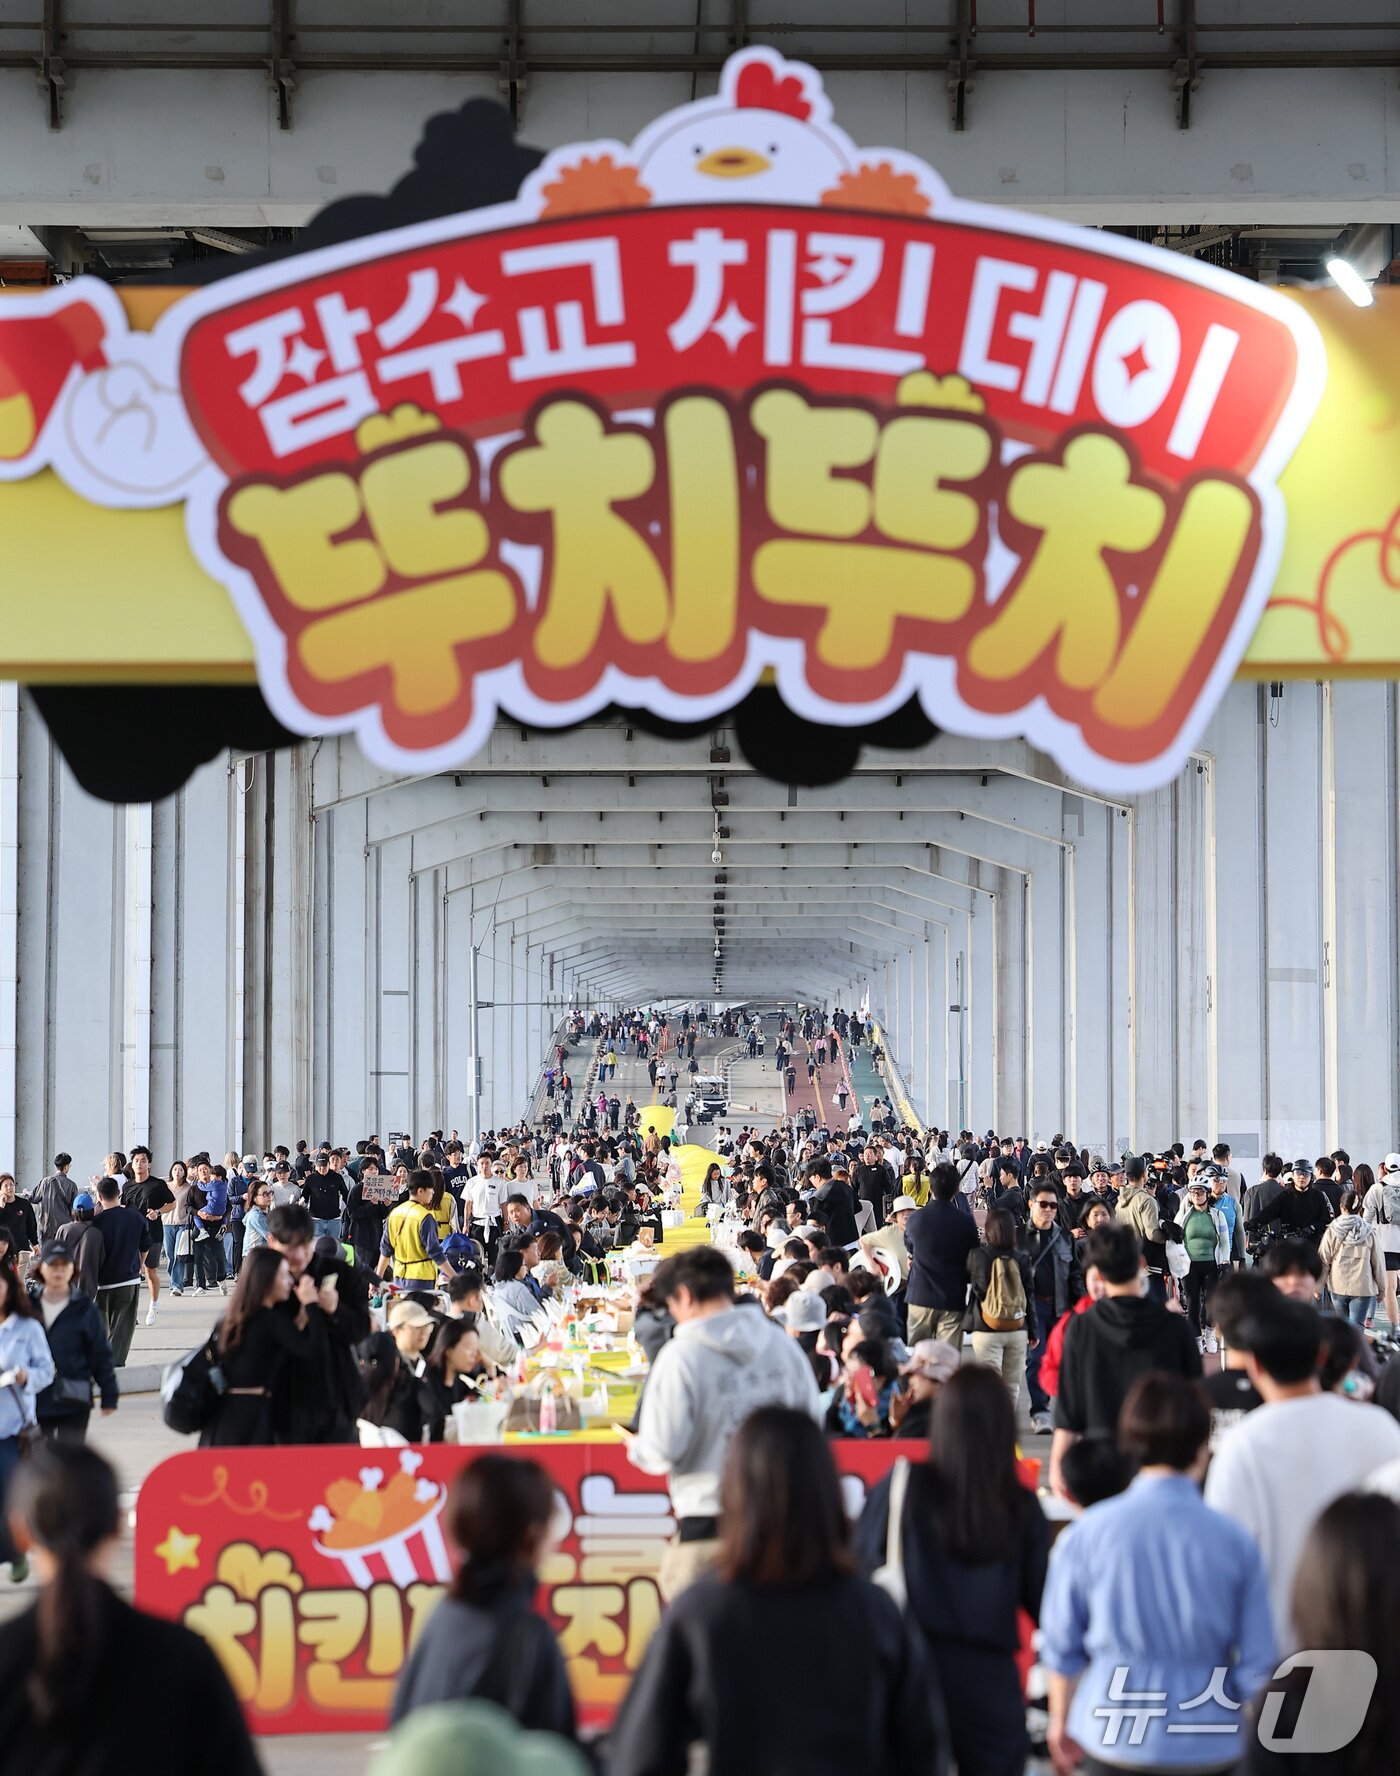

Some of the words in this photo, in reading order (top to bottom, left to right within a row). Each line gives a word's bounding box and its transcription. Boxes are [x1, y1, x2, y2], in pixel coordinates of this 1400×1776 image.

[224, 236, 636, 458] 잠수교
[666, 228, 935, 376] 치킨
[957, 256, 1239, 460] 데이
[225, 388, 1256, 732] 뚜치뚜치
[450, 1175, 468, 1188] POLO
